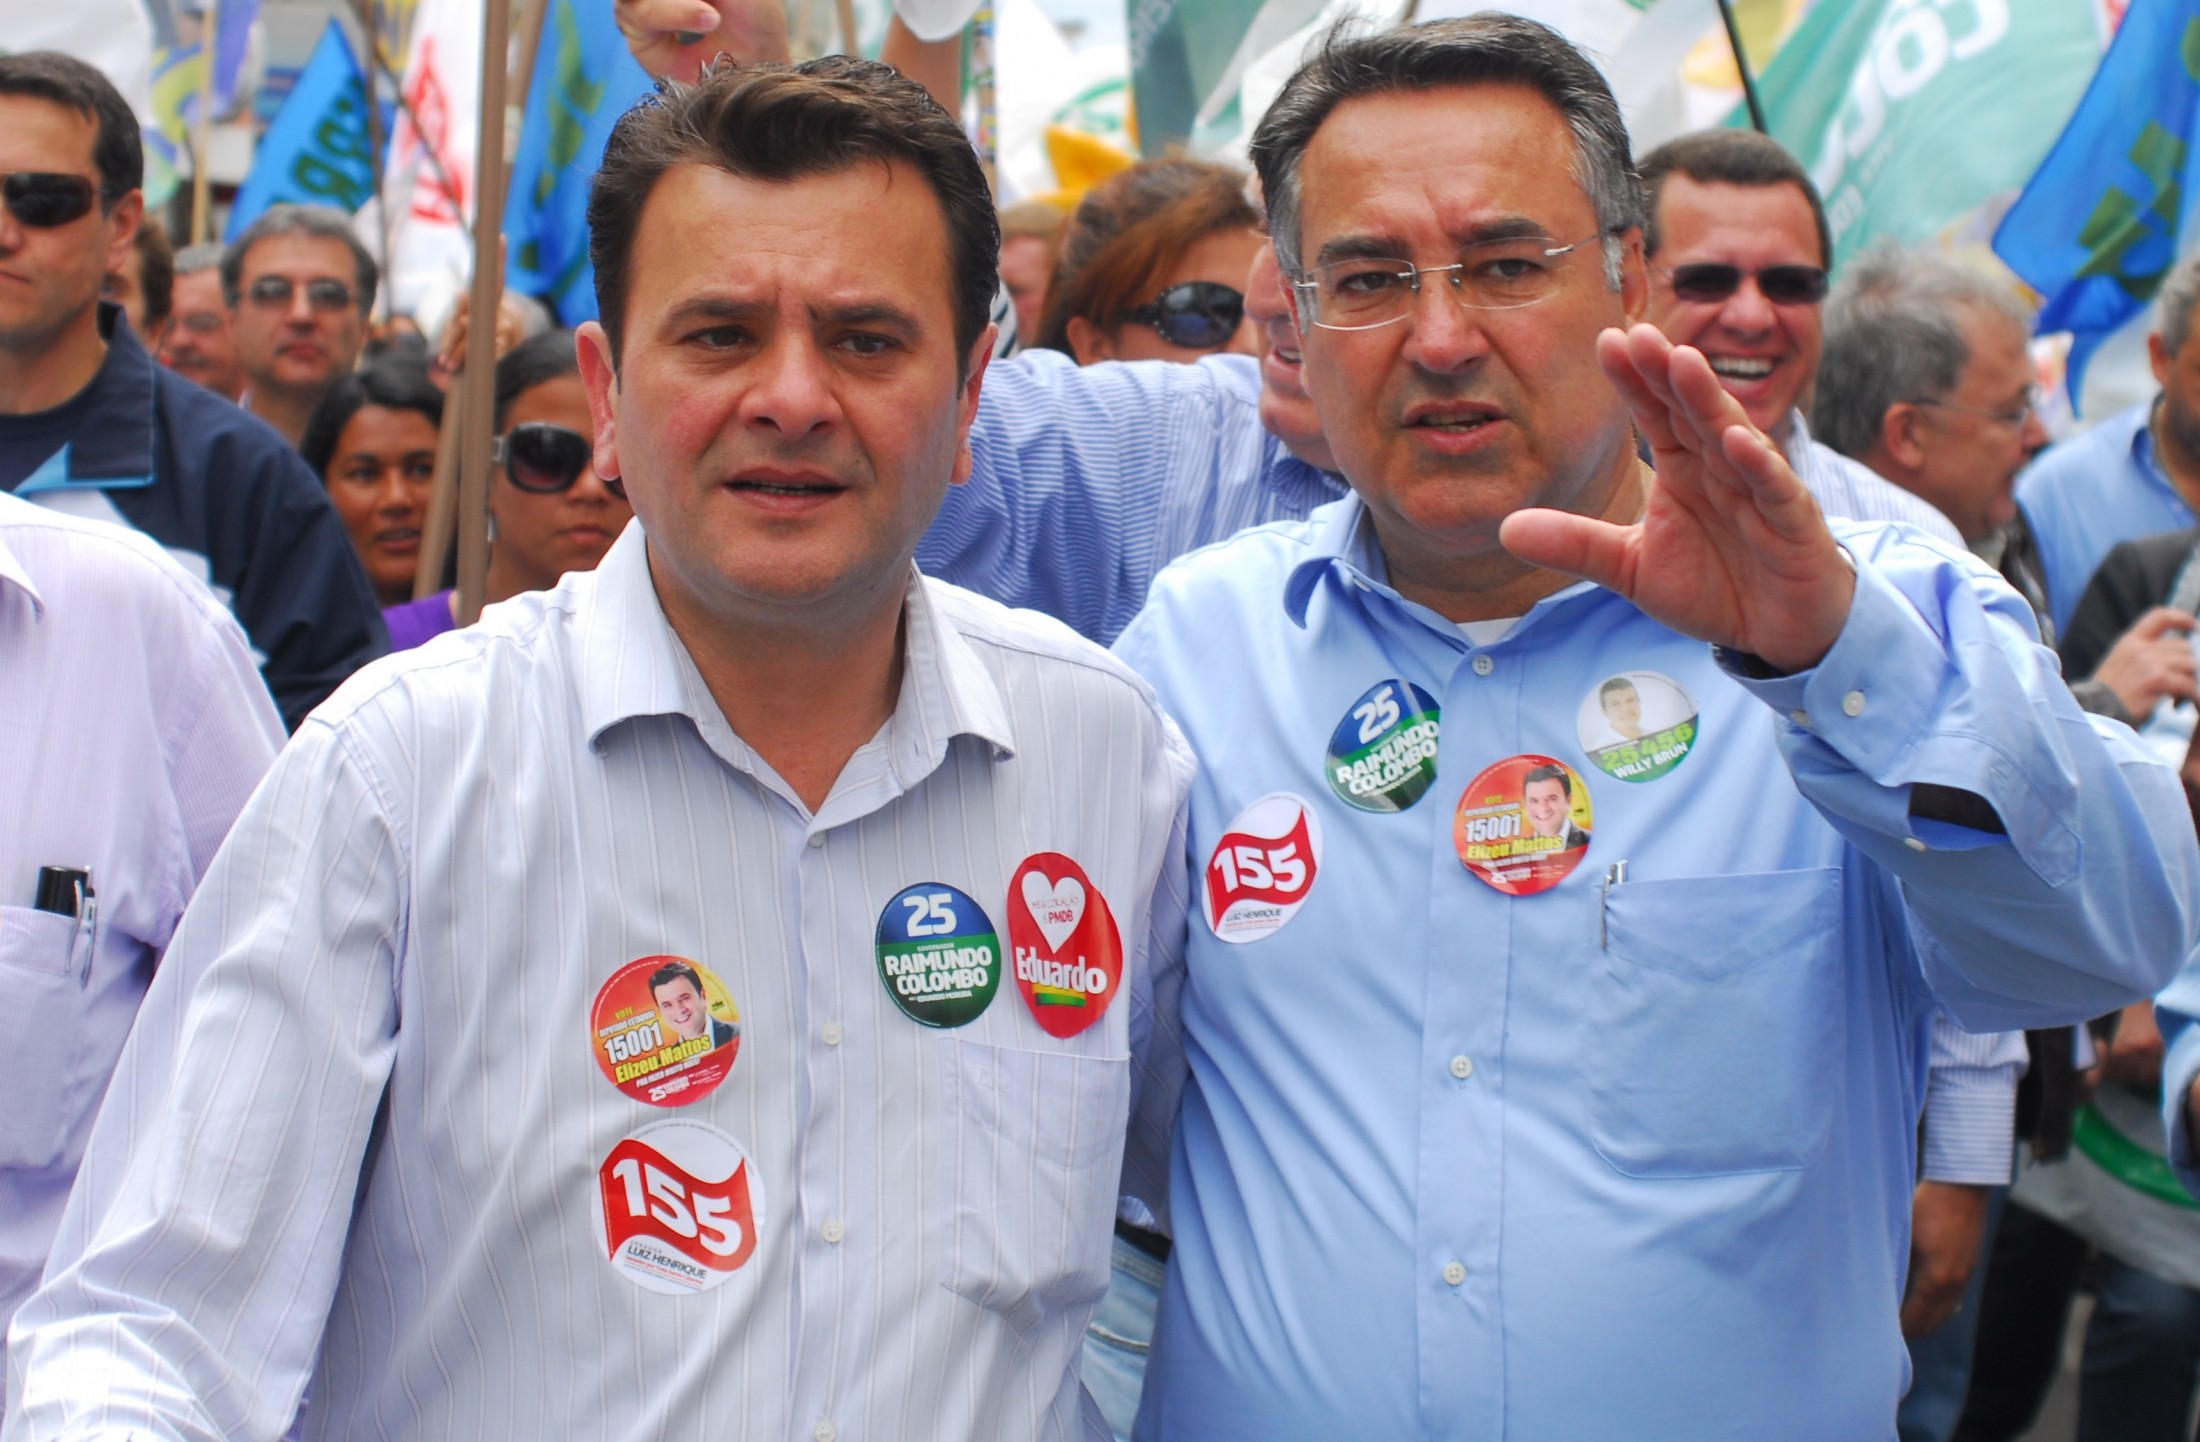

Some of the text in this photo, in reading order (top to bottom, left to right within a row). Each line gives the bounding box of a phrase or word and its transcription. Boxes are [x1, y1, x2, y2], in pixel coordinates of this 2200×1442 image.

[1353, 686, 1400, 744] 25
[1335, 720, 1440, 784] RAIMUNDO
[1349, 739, 1438, 795] COLOMBO
[1612, 757, 1652, 779] WILLY
[1652, 741, 1689, 765] BRUN
[1465, 812, 1521, 843] 15001
[1511, 835, 1562, 856] Mattos
[1213, 842, 1307, 894] 155
[903, 893, 957, 937] 25
[1048, 909, 1074, 924] PMDB
[884, 946, 993, 976] RAIMUNDO
[896, 967, 988, 995] COLOMBO
[1015, 946, 1108, 995] Eduardo
[615, 1006, 633, 1020] VOTE
[604, 1021, 663, 1065] 15001
[615, 1055, 659, 1084] Elizeu
[659, 1034, 712, 1067] Mattos
[612, 1158, 742, 1257] 155
[627, 1245, 652, 1261] LUIZ
[652, 1253, 708, 1279] HENRIQUE
